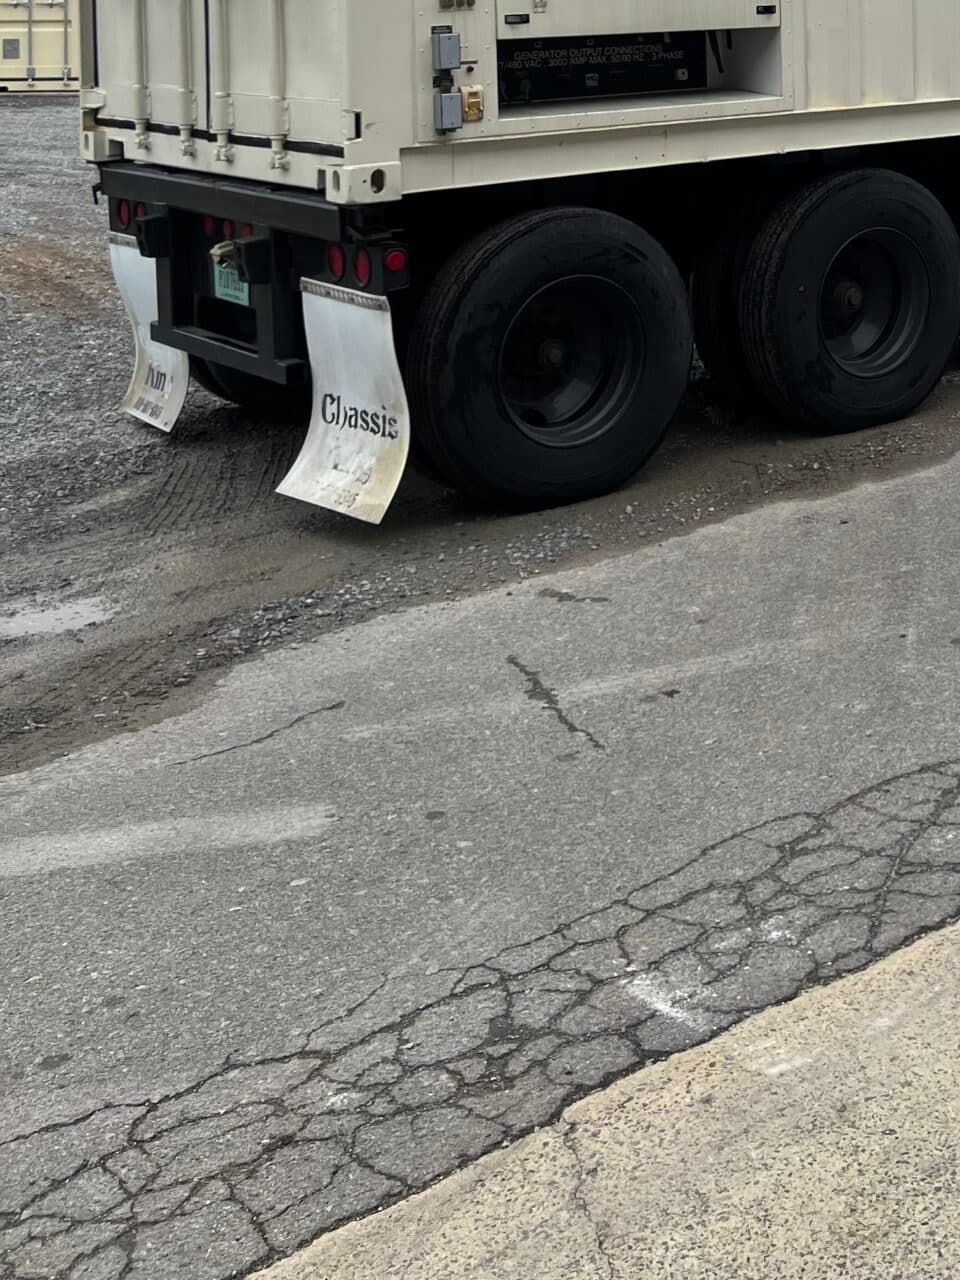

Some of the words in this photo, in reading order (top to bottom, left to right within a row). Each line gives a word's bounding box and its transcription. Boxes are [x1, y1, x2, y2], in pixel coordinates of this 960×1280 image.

[514, 49, 567, 60] GENERATOR
[569, 47, 602, 57] OUTPUT
[604, 43, 663, 55] CONNECTIONS
[569, 56, 587, 65] AMP
[658, 50, 684, 59] PHASE
[321, 393, 398, 440] Chassis
